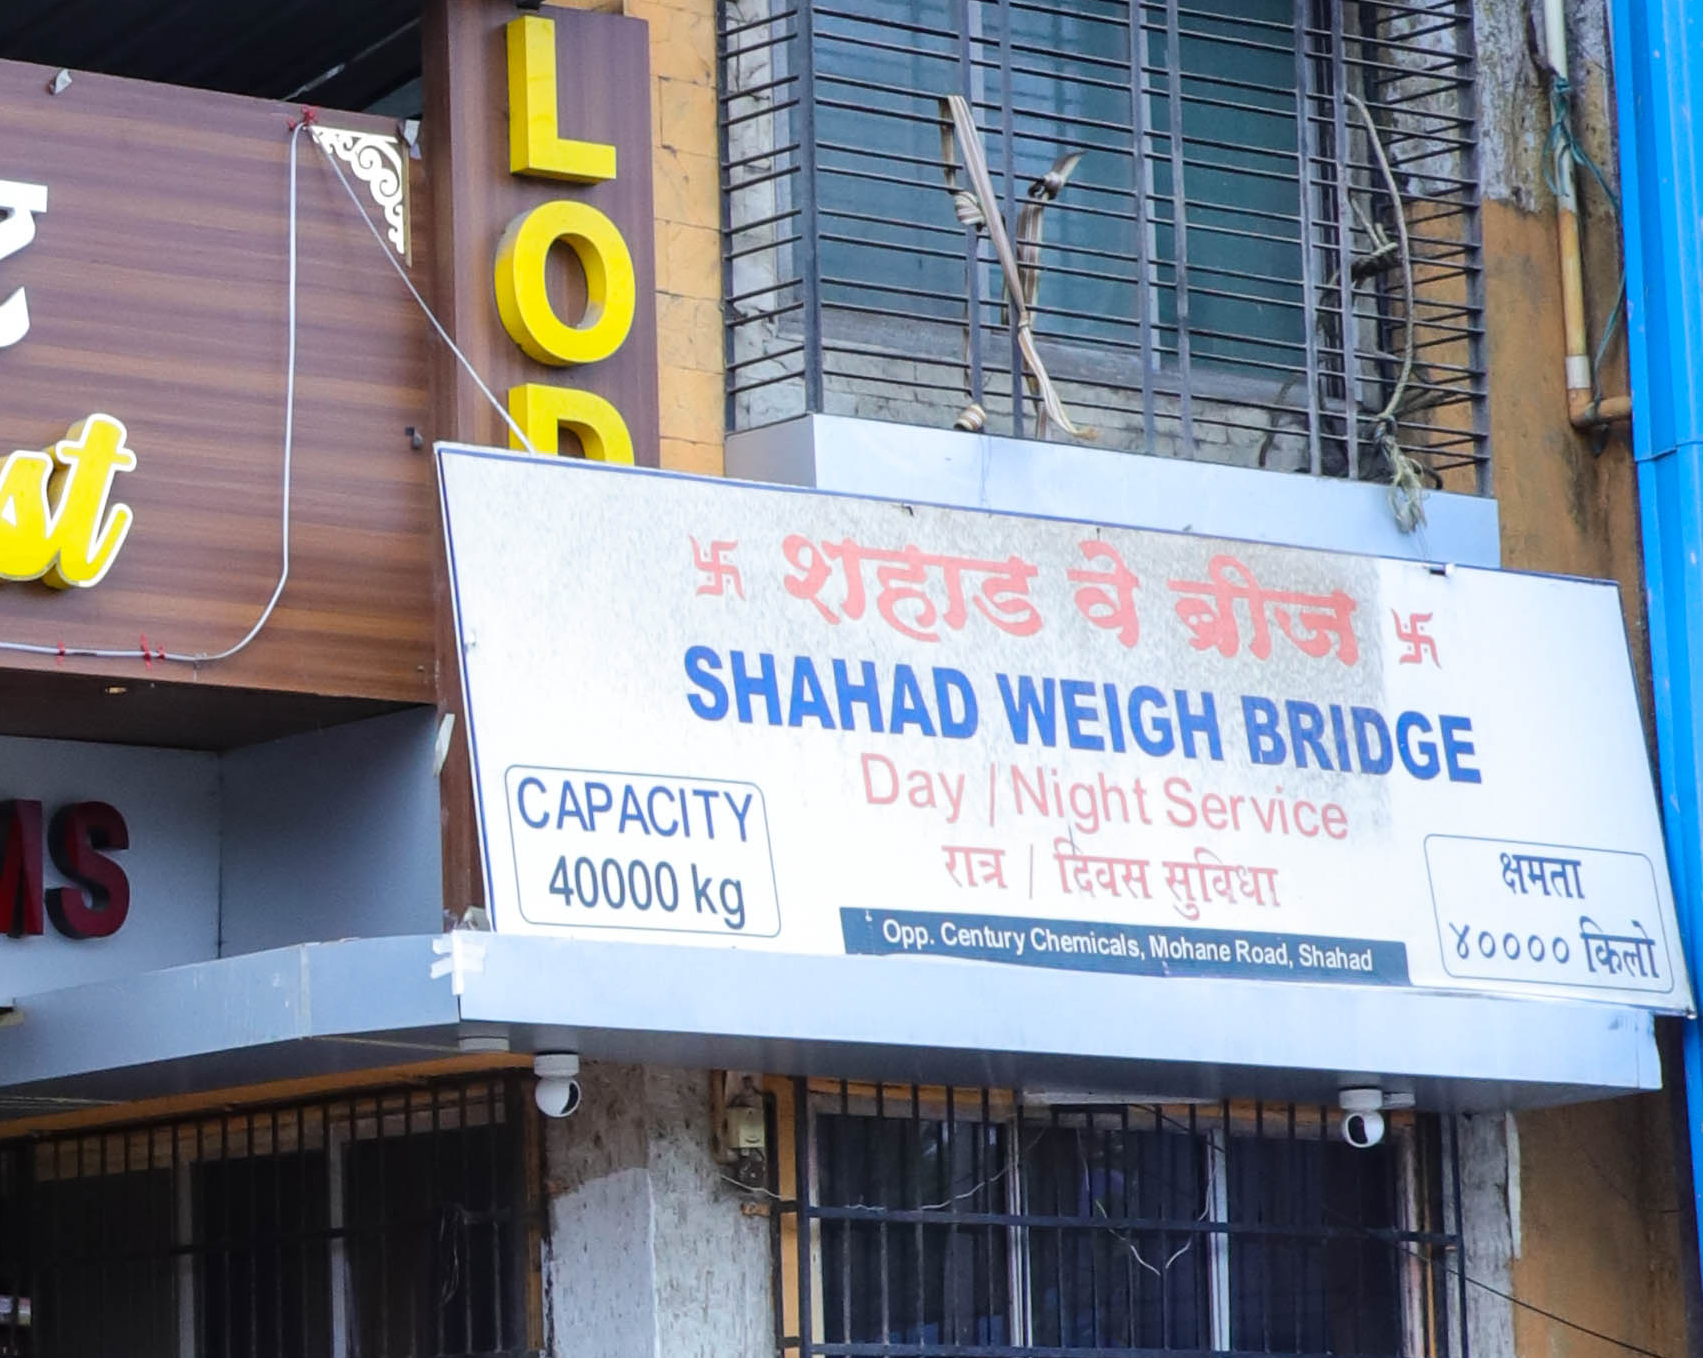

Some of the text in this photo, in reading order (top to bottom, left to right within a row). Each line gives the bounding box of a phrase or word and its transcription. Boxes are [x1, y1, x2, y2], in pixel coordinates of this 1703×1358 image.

[781, 533, 1044, 642] शहाड
[683, 644, 1483, 785] SHAHAD WEIGH BRIDGE
[517, 775, 753, 843] CAPACITY
[861, 752, 966, 824] Day
[1010, 764, 1153, 835] Night
[1163, 776, 1349, 840] Service
[548, 855, 746, 931] 40000 kg
[940, 844, 1009, 889] रात्र
[1053, 837, 1153, 900] दिवस
[1499, 852, 1586, 900] क्षमता
[882, 918, 1374, 972] Opp. Century Chemicals, Mohane Road, Shahad
[1579, 915, 1660, 979] किलो
